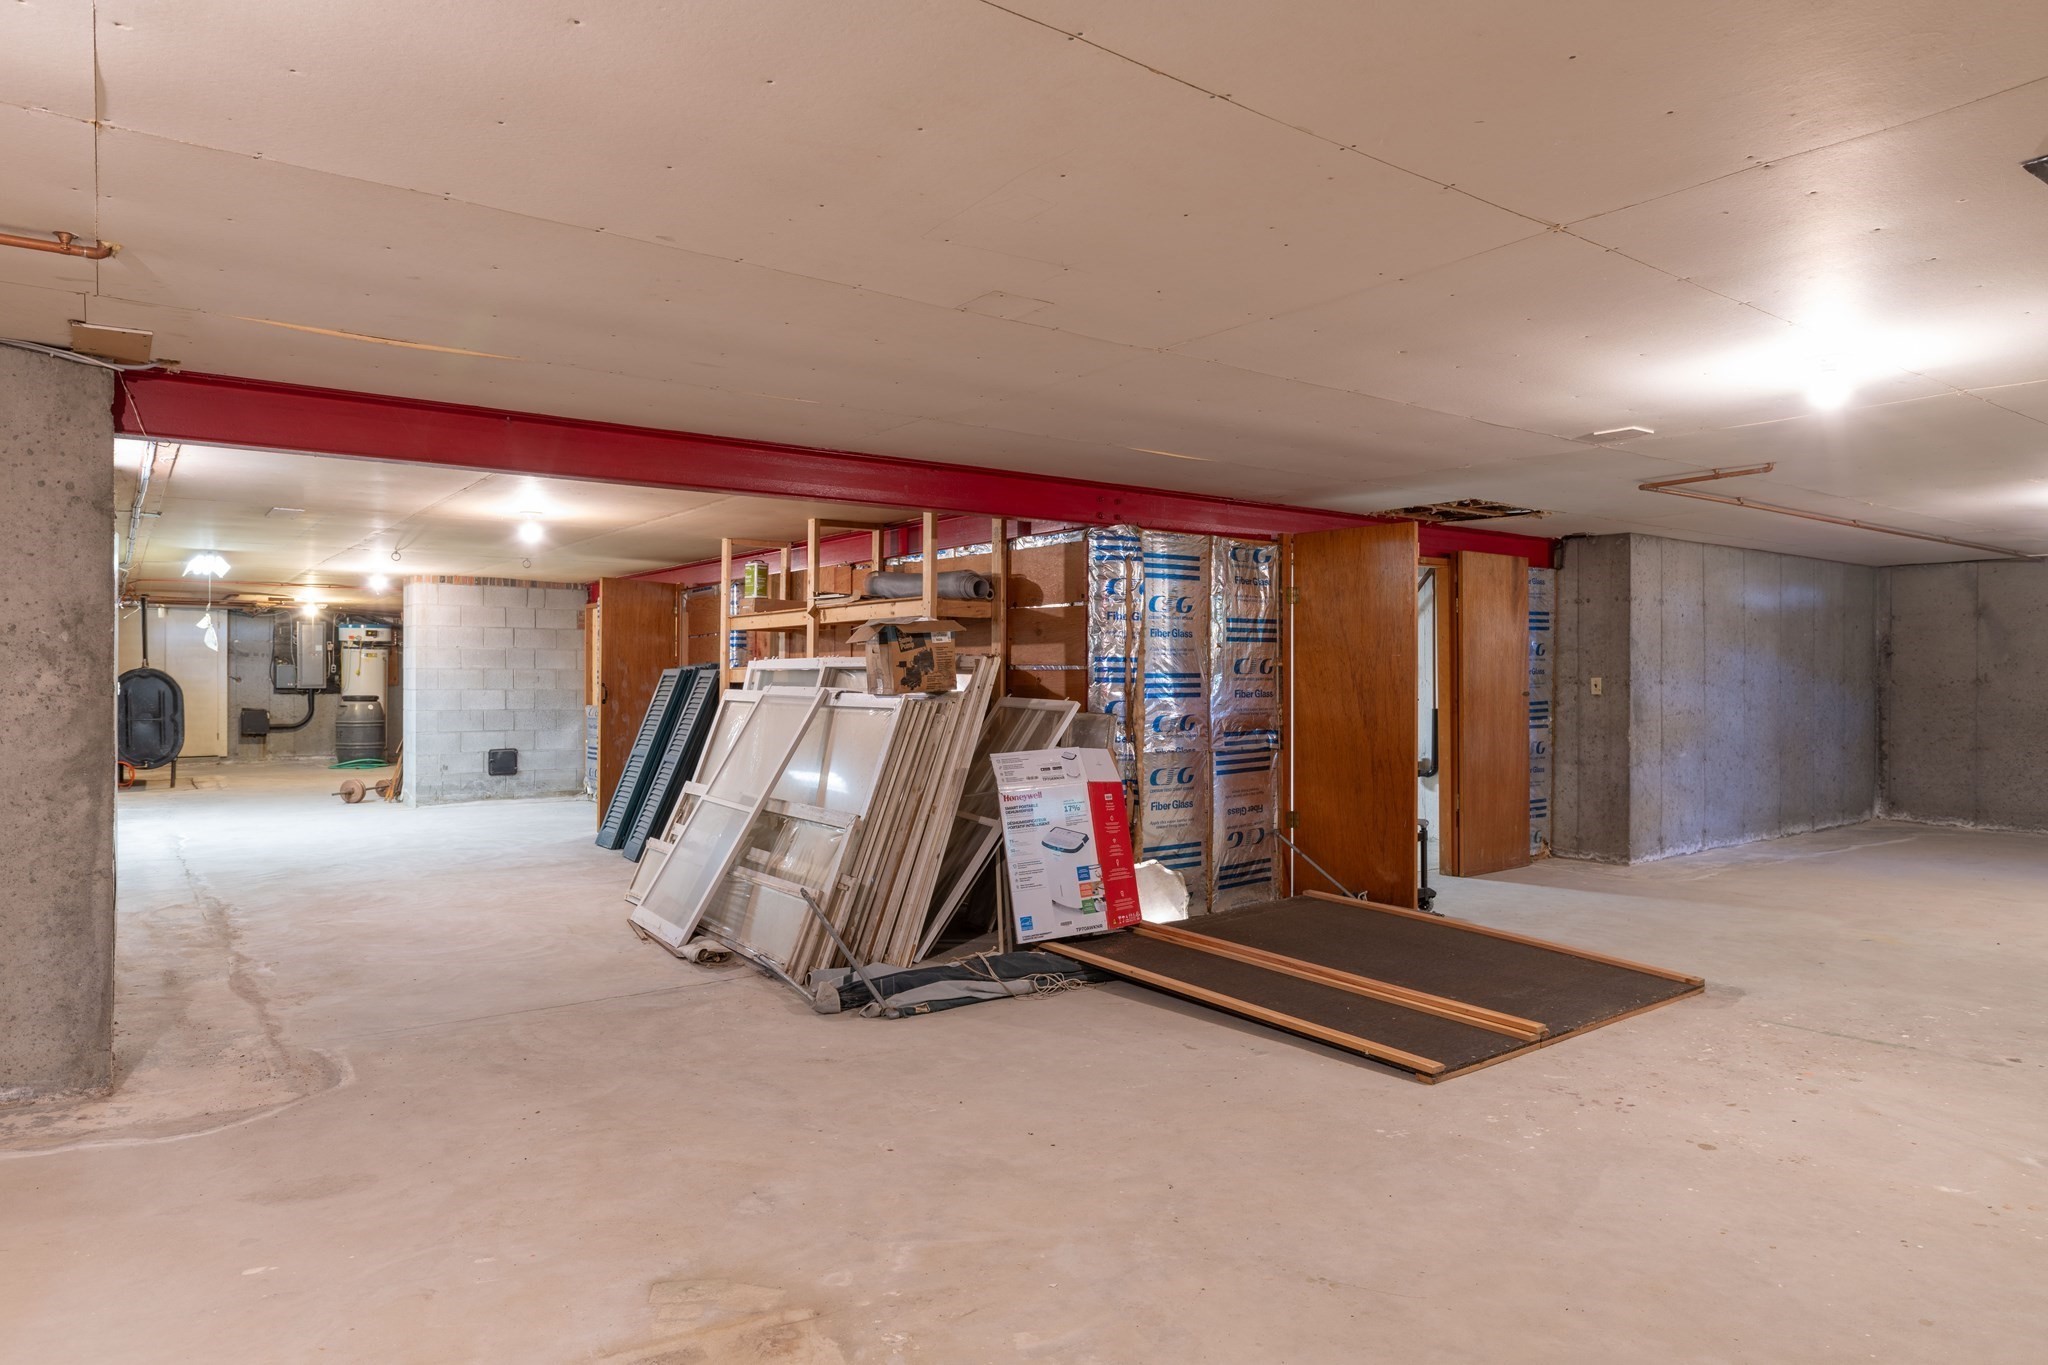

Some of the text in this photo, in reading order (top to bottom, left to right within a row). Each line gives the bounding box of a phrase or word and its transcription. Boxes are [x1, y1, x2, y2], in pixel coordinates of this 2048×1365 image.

[1235, 576, 1252, 585] Fiber
[1150, 628, 1193, 638] Fiber Glass
[1234, 689, 1274, 698] Fiber Glass
[1003, 791, 1043, 802] Honeywell
[1064, 804, 1081, 813] 17%
[1151, 799, 1194, 811] Fiber Glass
[1227, 806, 1247, 816] Glass
